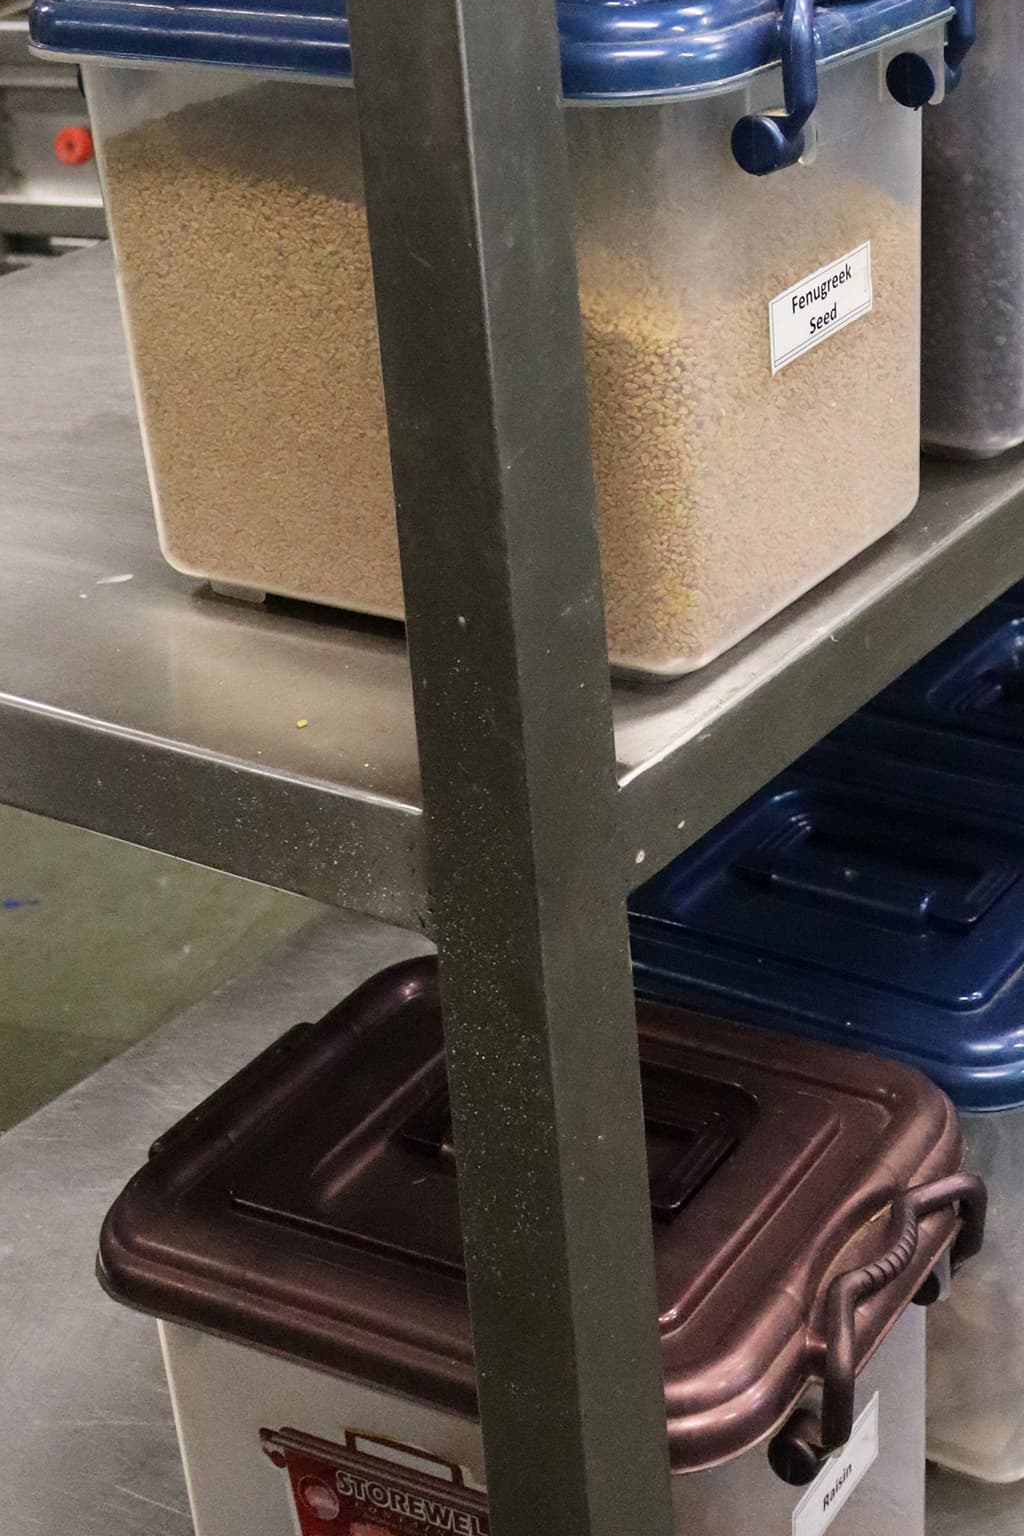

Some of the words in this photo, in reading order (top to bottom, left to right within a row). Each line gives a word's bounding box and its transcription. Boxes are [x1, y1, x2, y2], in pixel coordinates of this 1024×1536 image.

[791, 263, 852, 314] Fenugreek
[809, 302, 837, 334] Seed
[823, 1463, 852, 1512] Raisin
